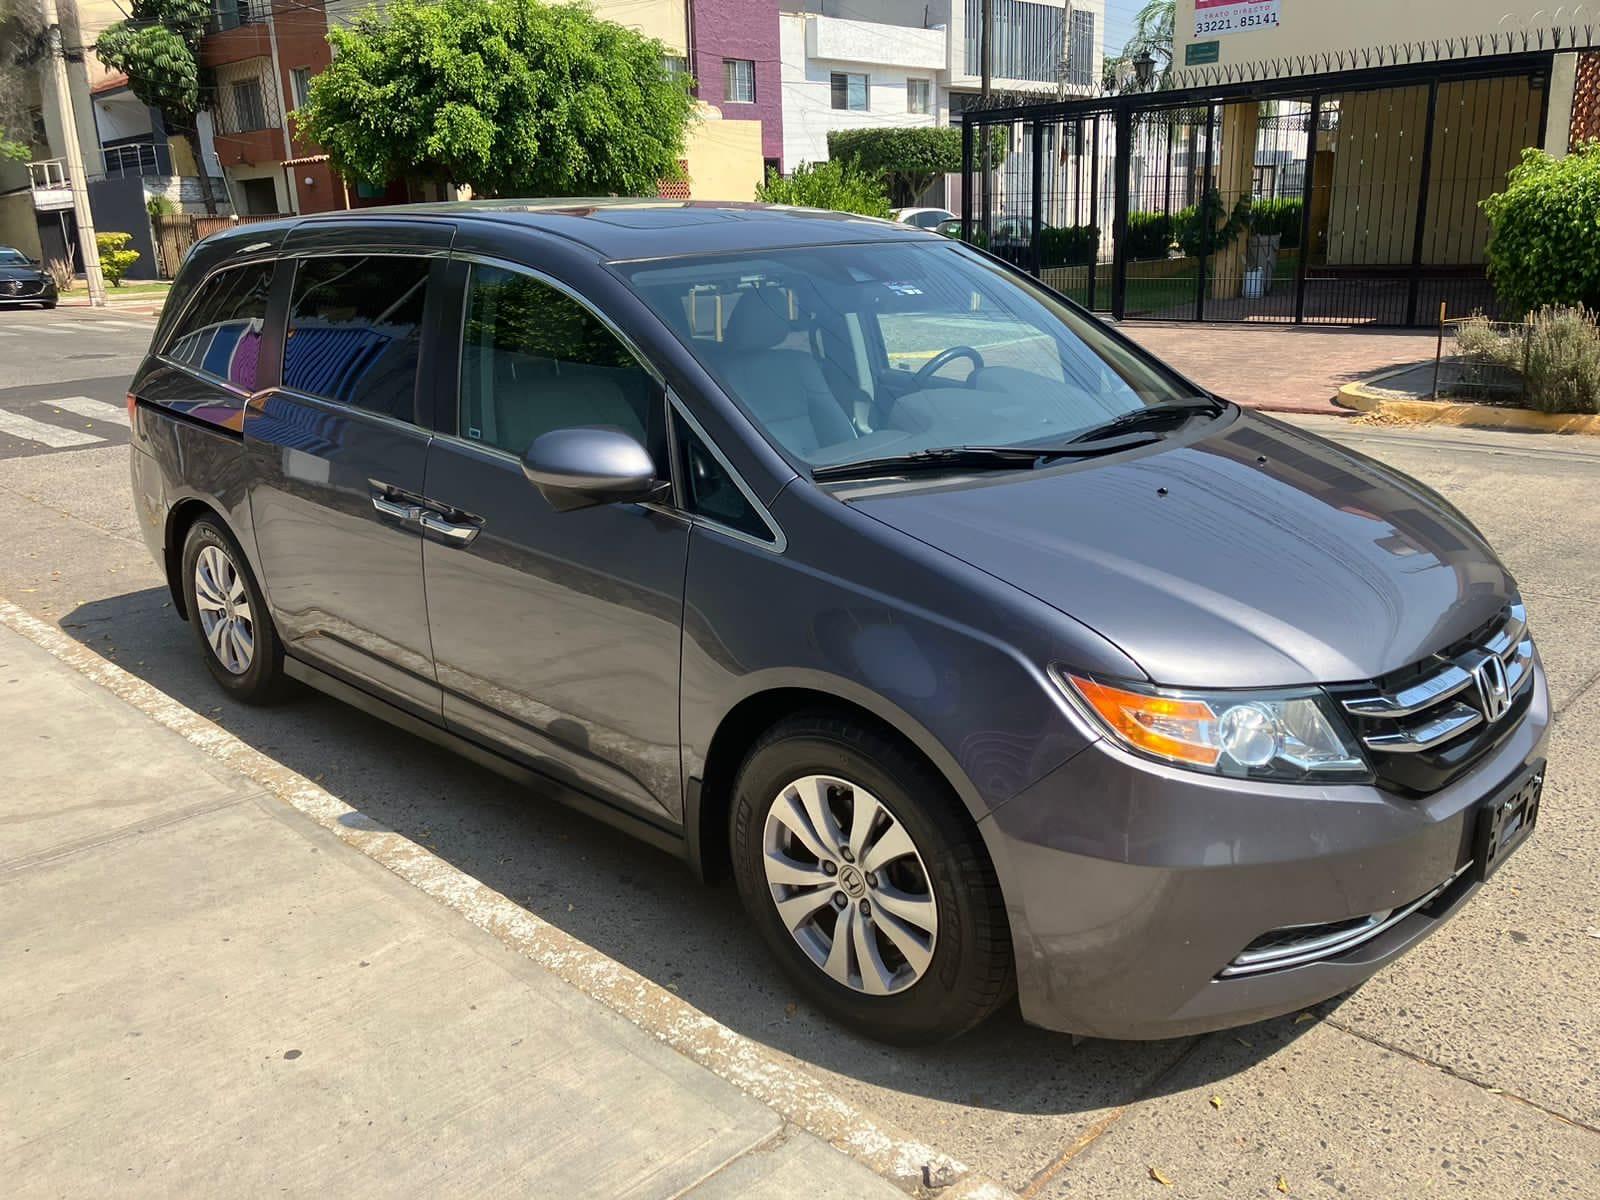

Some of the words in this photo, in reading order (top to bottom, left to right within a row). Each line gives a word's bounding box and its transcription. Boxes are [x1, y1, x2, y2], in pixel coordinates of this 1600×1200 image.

[1204, 11, 1229, 19] TRATO
[1233, 5, 1271, 15] DIRECTO
[1196, 12, 1277, 33] 33221.85141
